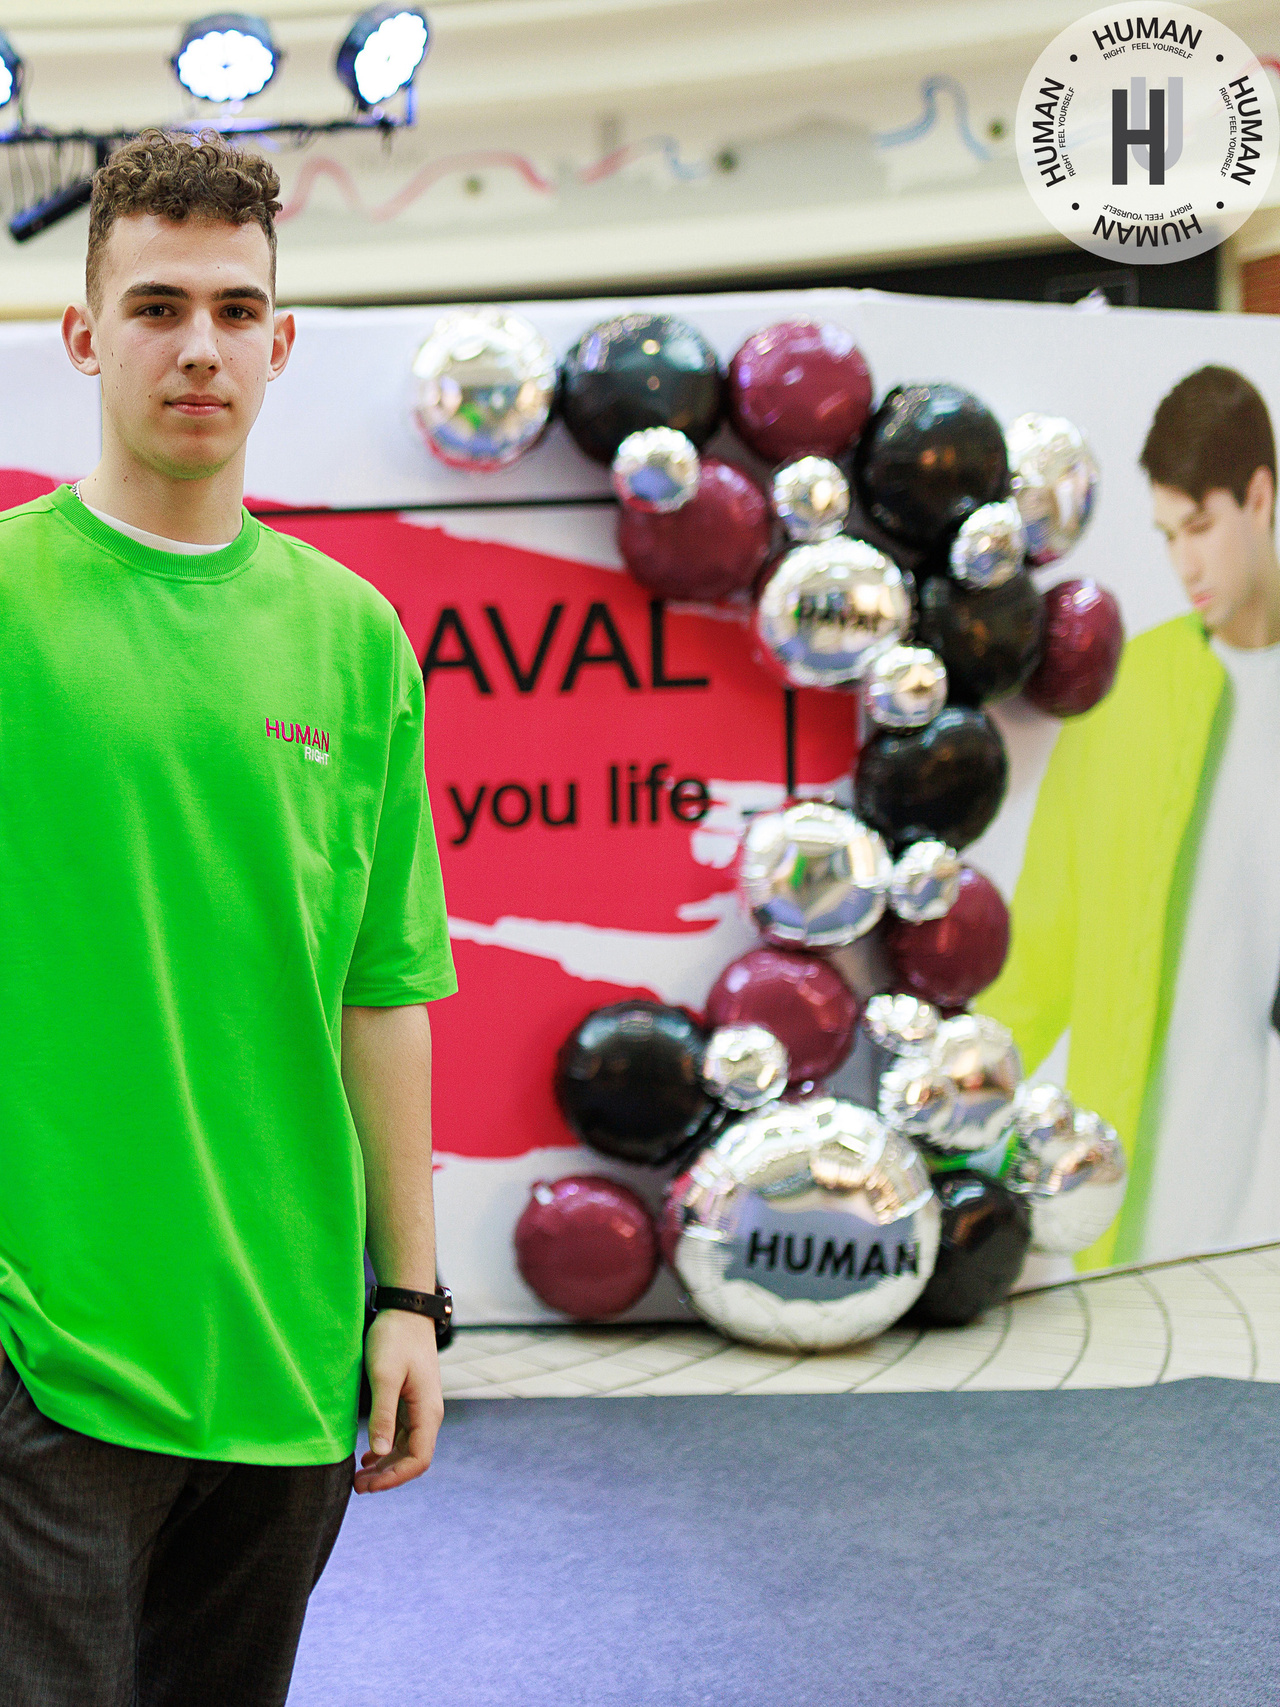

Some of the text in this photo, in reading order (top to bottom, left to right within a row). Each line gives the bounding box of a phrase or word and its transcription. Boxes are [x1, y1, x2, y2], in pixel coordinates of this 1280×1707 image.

[396, 600, 710, 695] AVAL
[265, 717, 330, 752] HUMAN
[304, 746, 329, 765] RIGHT
[448, 785, 579, 846] you
[609, 763, 710, 822] life
[747, 1229, 919, 1280] HUMAN
